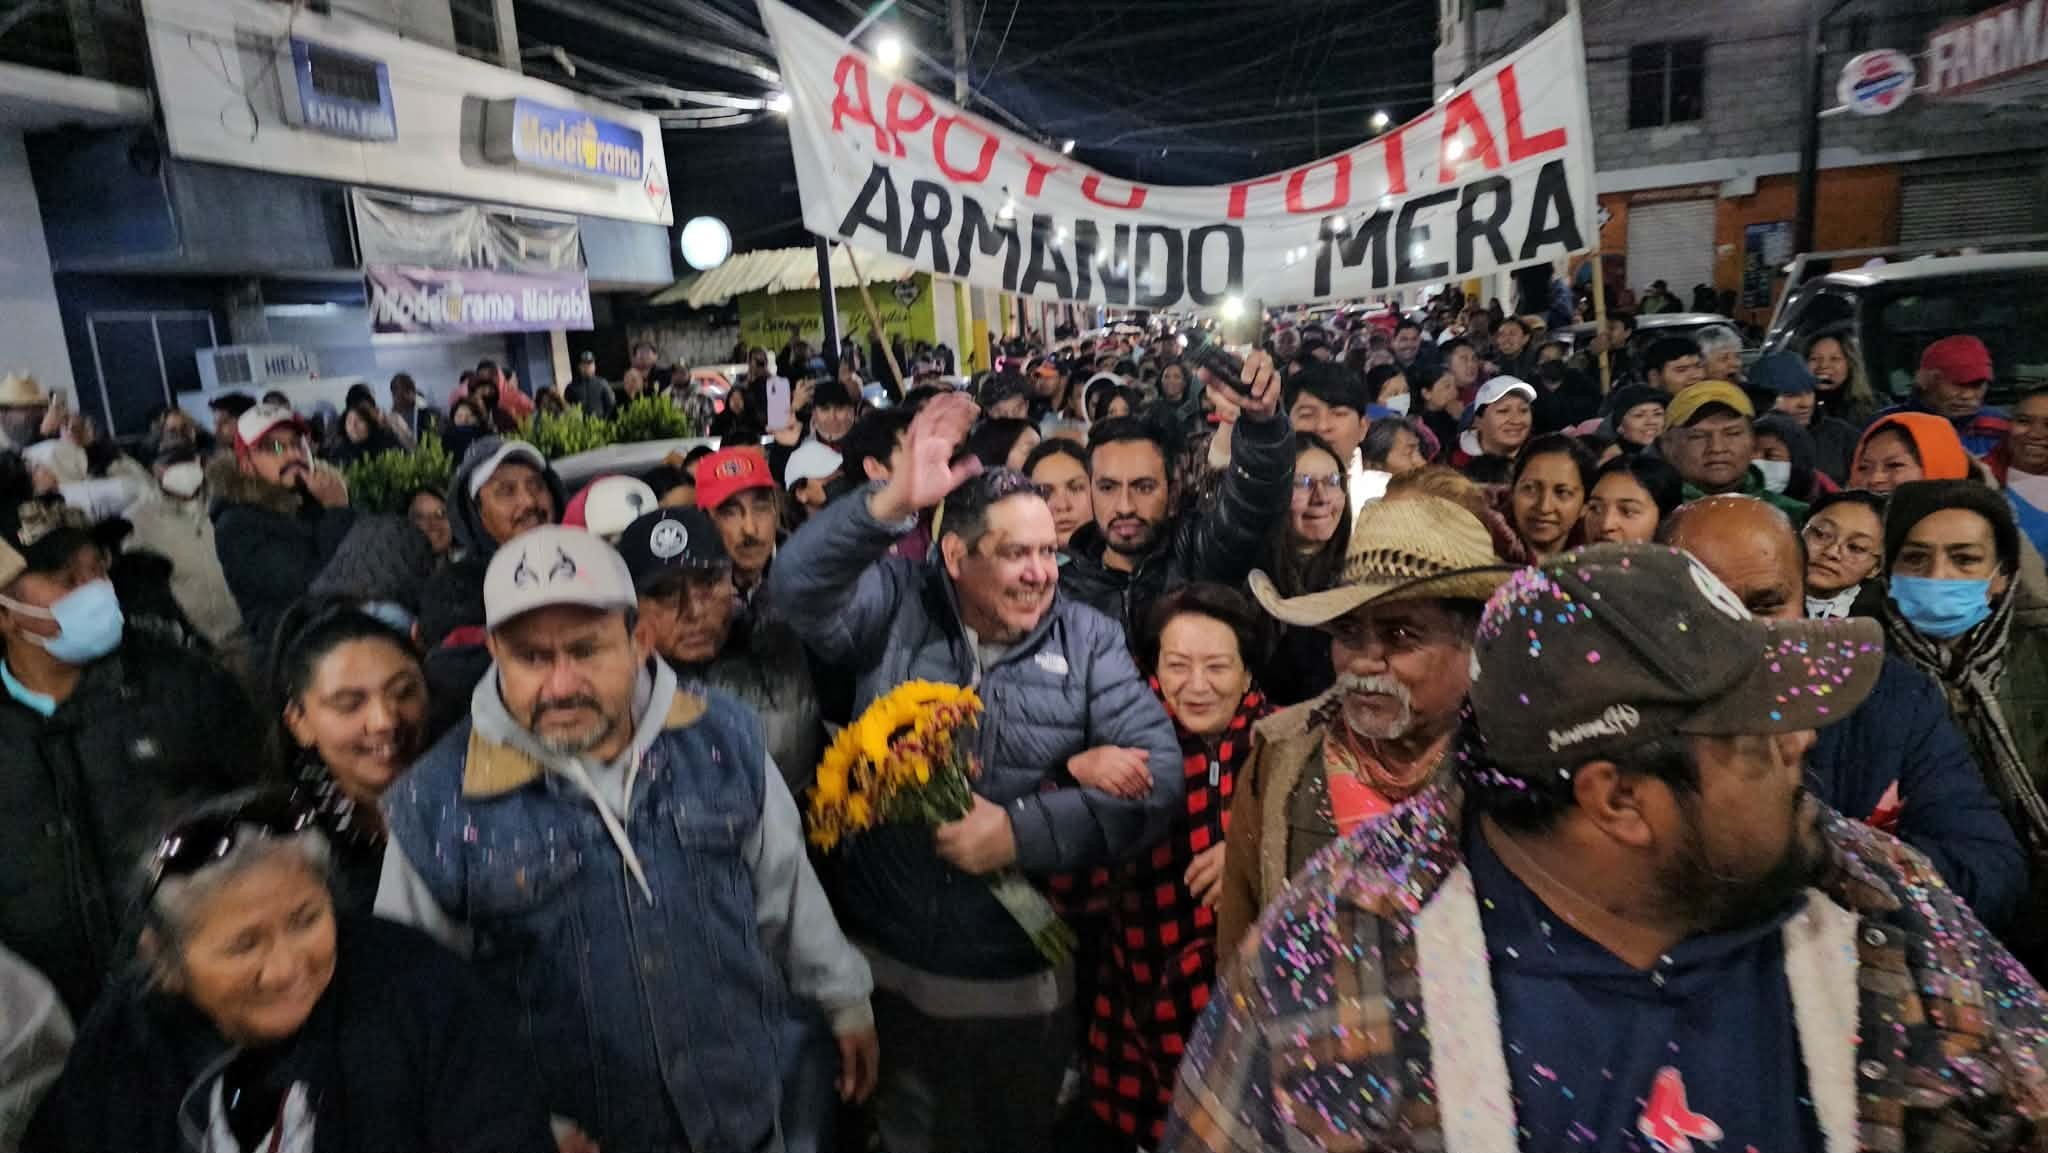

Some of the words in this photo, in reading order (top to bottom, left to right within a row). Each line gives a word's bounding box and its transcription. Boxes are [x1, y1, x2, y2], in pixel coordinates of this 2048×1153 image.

[1928, 0, 2048, 93] FARM
[520, 111, 640, 177] Modelorama
[1226, 64, 1567, 219] TOTAL
[838, 161, 1244, 307] ARMANDO
[1313, 158, 1584, 297] MERA
[522, 286, 591, 323] Nairobi
